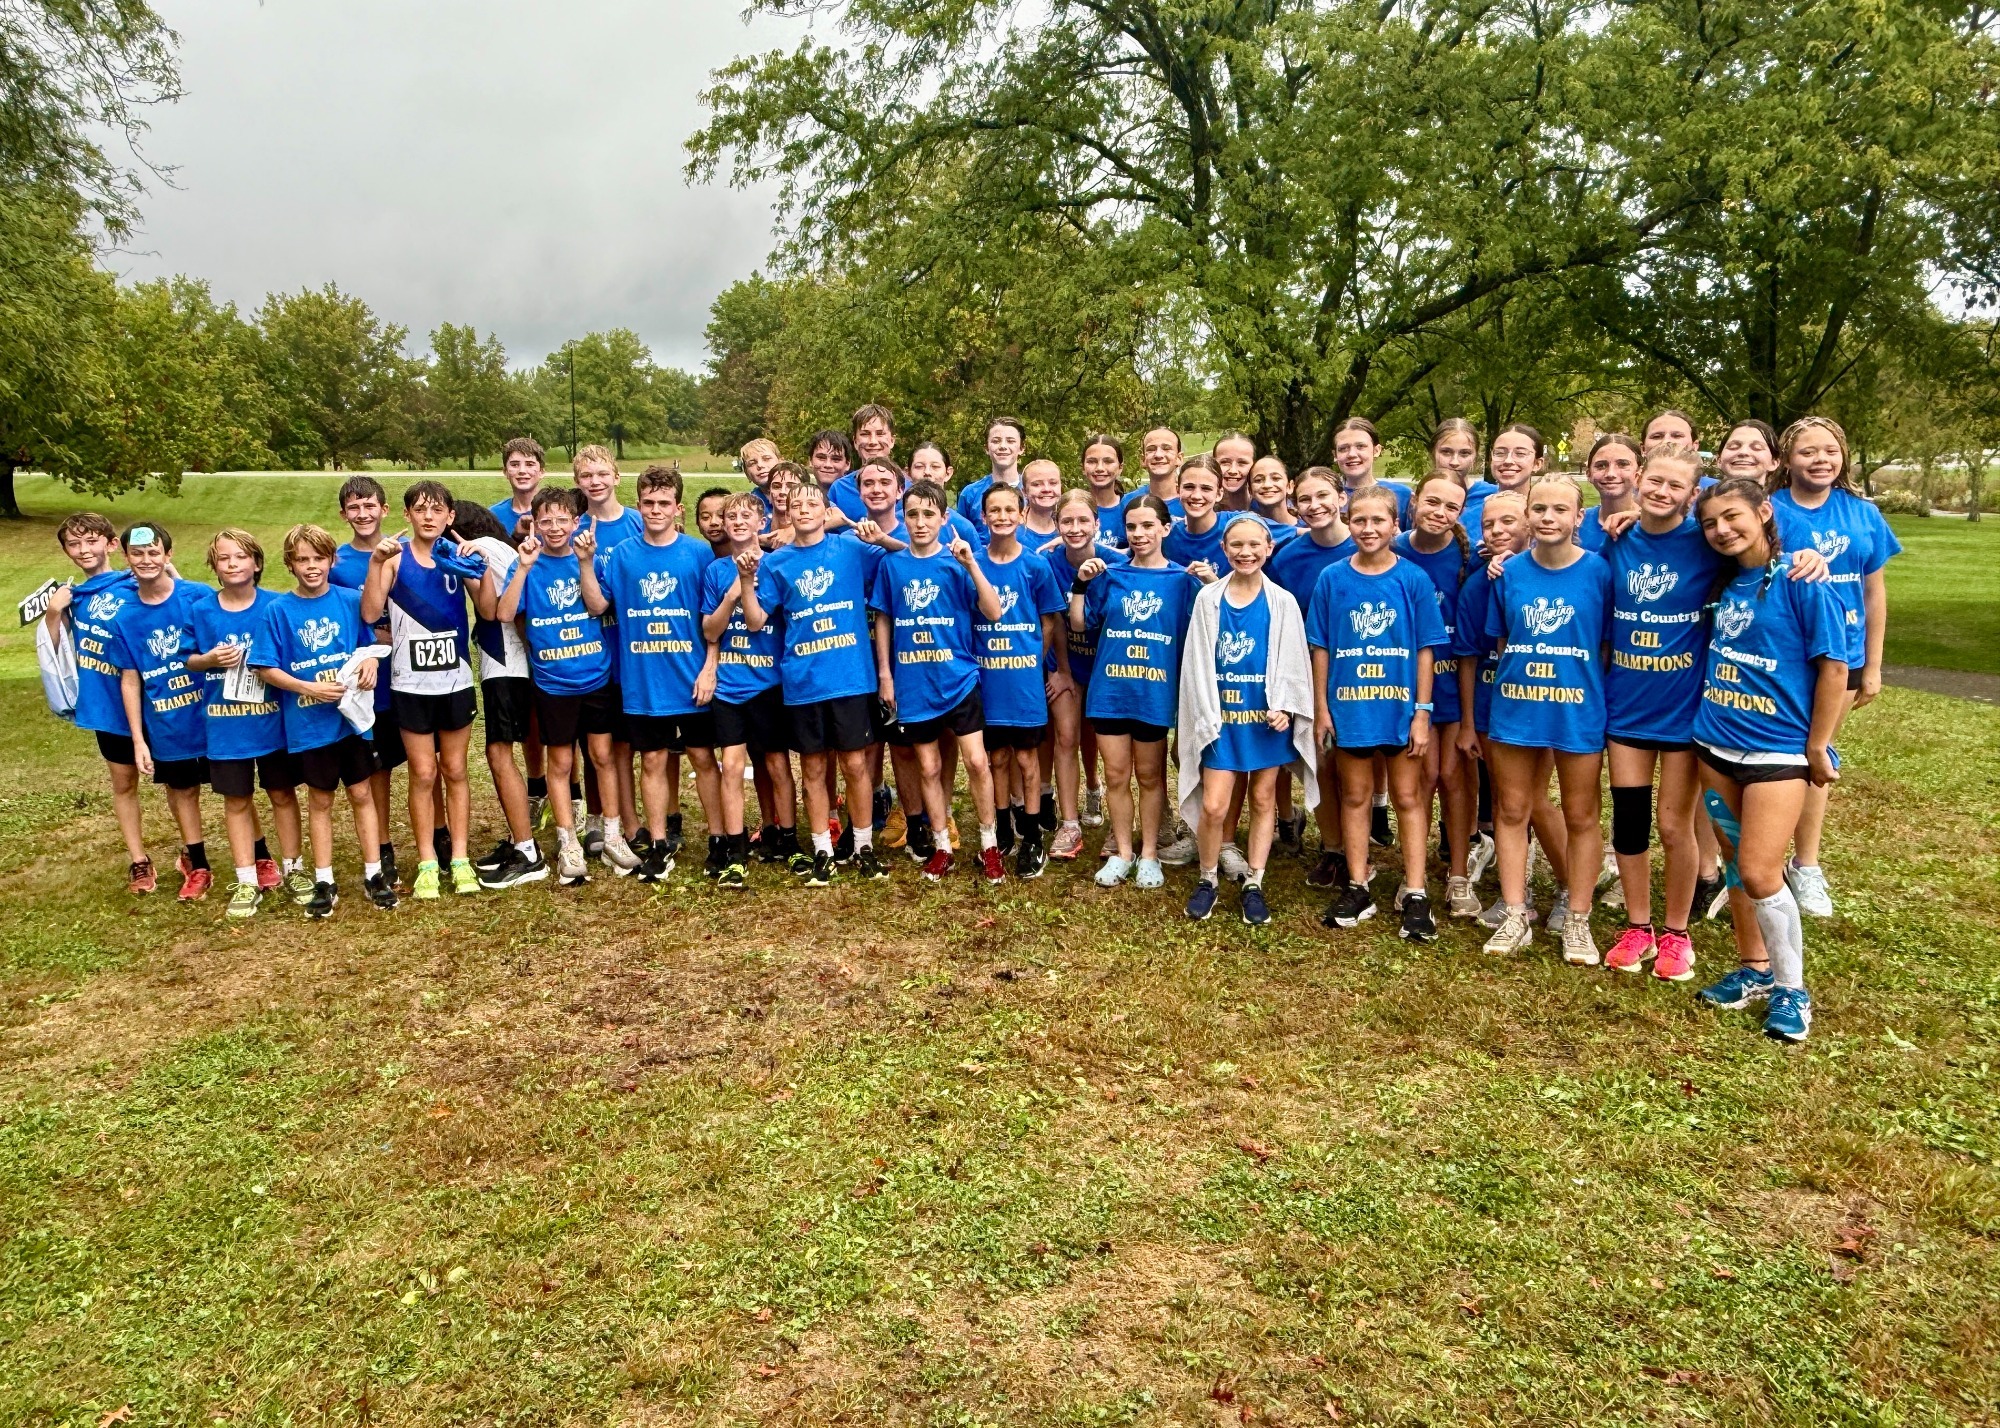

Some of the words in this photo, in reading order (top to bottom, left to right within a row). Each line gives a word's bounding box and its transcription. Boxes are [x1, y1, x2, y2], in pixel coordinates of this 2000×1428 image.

[639, 575, 678, 603] Wyoming
[795, 568, 835, 601] Wyoming
[1627, 570, 1678, 604] Wyoming
[903, 582, 940, 612] Wyoming
[627, 608, 650, 617] Cross
[653, 607, 691, 619] Country
[815, 601, 853, 613] Country
[1121, 595, 1163, 624] Wyoming
[532, 617, 562, 627] Cross
[895, 618, 914, 627] Cross
[917, 616, 954, 627] Country
[1350, 606, 1397, 640] Wyoming
[1522, 603, 1575, 636] Wyoming
[1641, 611, 1699, 623] Country
[560, 627, 583, 640] CHL
[647, 622, 672, 635] CHL
[813, 618, 837, 633] CHL
[994, 622, 1035, 632] Country
[298, 618, 340, 652] Wyoming
[731, 636, 751, 649] CHL
[912, 631, 934, 644] CHL
[1107, 629, 1131, 639] Cross
[1134, 629, 1172, 644] Country
[1630, 630, 1662, 648] CHL
[80, 637, 104, 655] CHL
[415, 638, 456, 667] 6230
[539, 641, 602, 660] CHAMPIONS
[988, 638, 1013, 651] CHL
[1126, 645, 1149, 660] CHL
[1536, 643, 1589, 661] Country
[290, 659, 318, 671] Cross
[1721, 647, 1777, 672] Country
[1226, 672, 1265, 682] Countr
[1357, 664, 1386, 678] CHL
[1525, 662, 1556, 678] CHL
[1715, 663, 1741, 683] CHL
[168, 675, 194, 690] CHL
[1337, 686, 1410, 702] CHAMPIONS
[1501, 683, 1584, 703] CHAMPIONS
[207, 701, 279, 717] CHAMPIONS
